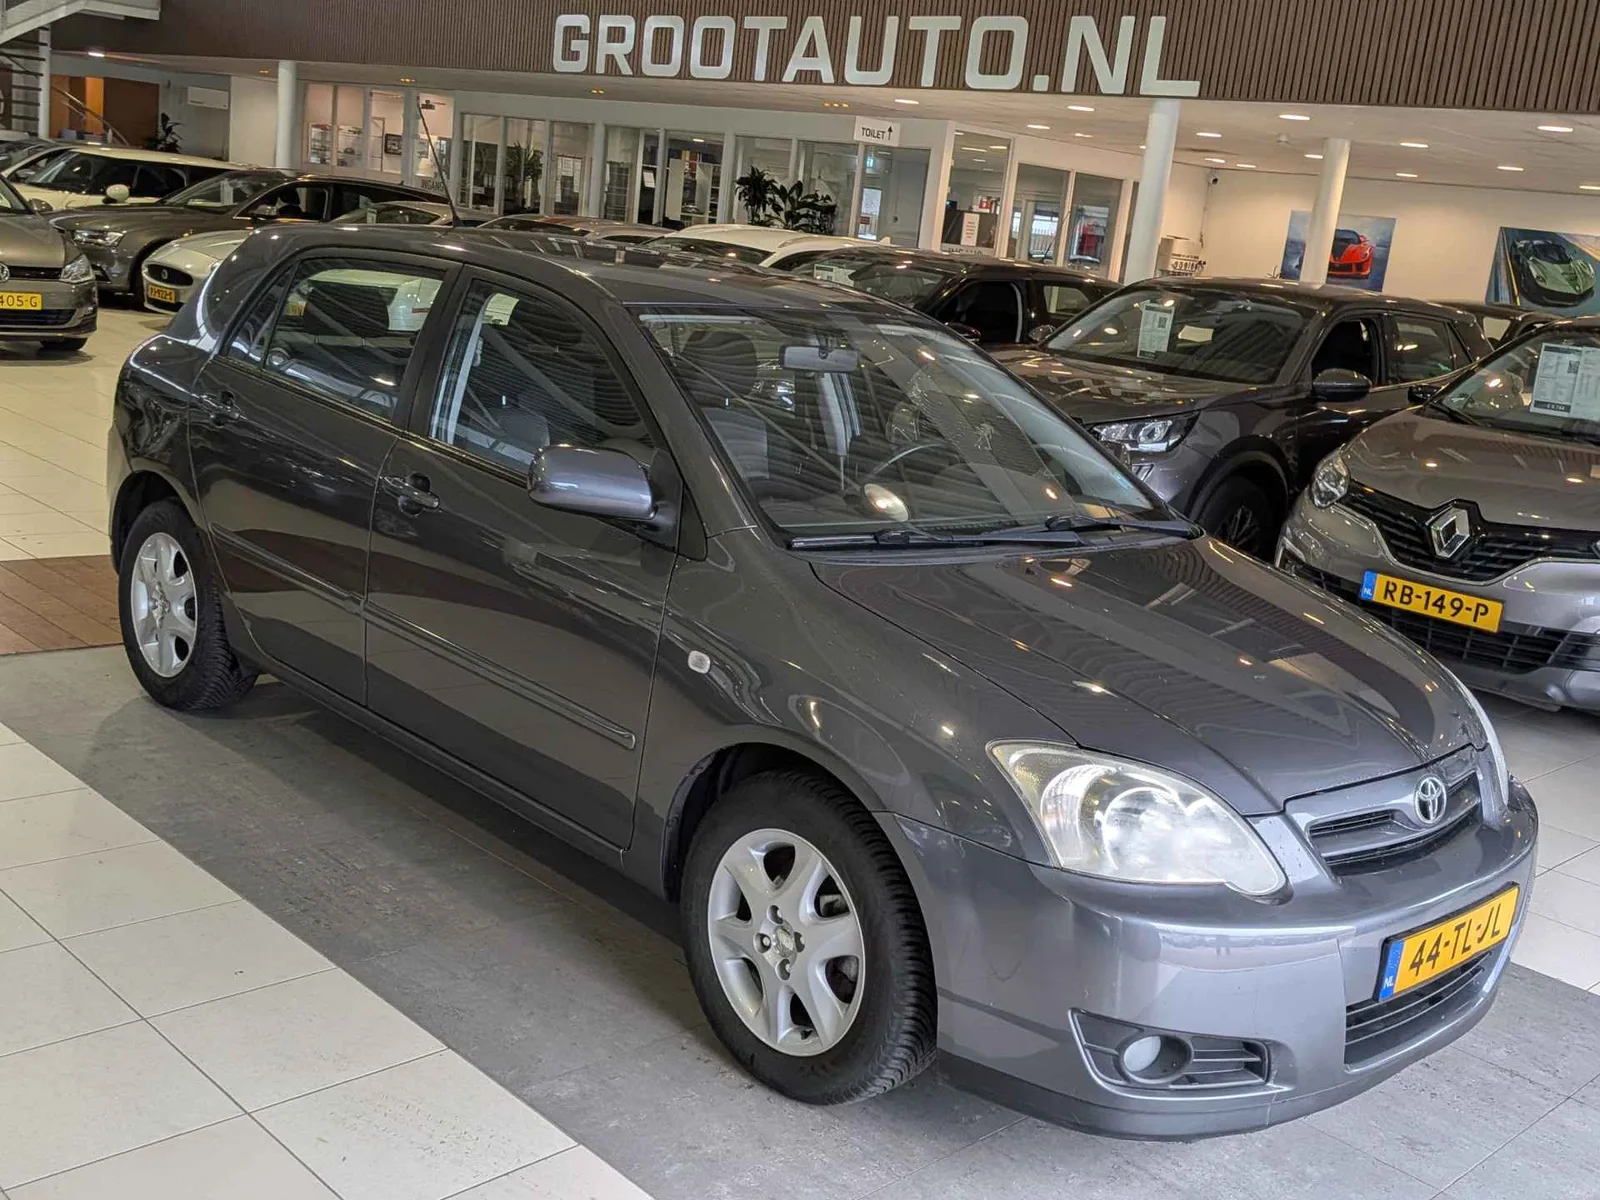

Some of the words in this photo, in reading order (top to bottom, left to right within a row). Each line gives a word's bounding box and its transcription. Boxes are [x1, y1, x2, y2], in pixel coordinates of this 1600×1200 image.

[552, 14, 1200, 97] GROOTAUTO.NL
[861, 126, 886, 140] TOILET
[1363, 587, 1373, 596] NL
[1383, 580, 1489, 623] RB-149-P
[1408, 902, 1502, 977] 44-TL-JL
[1383, 975, 1394, 989] NL
